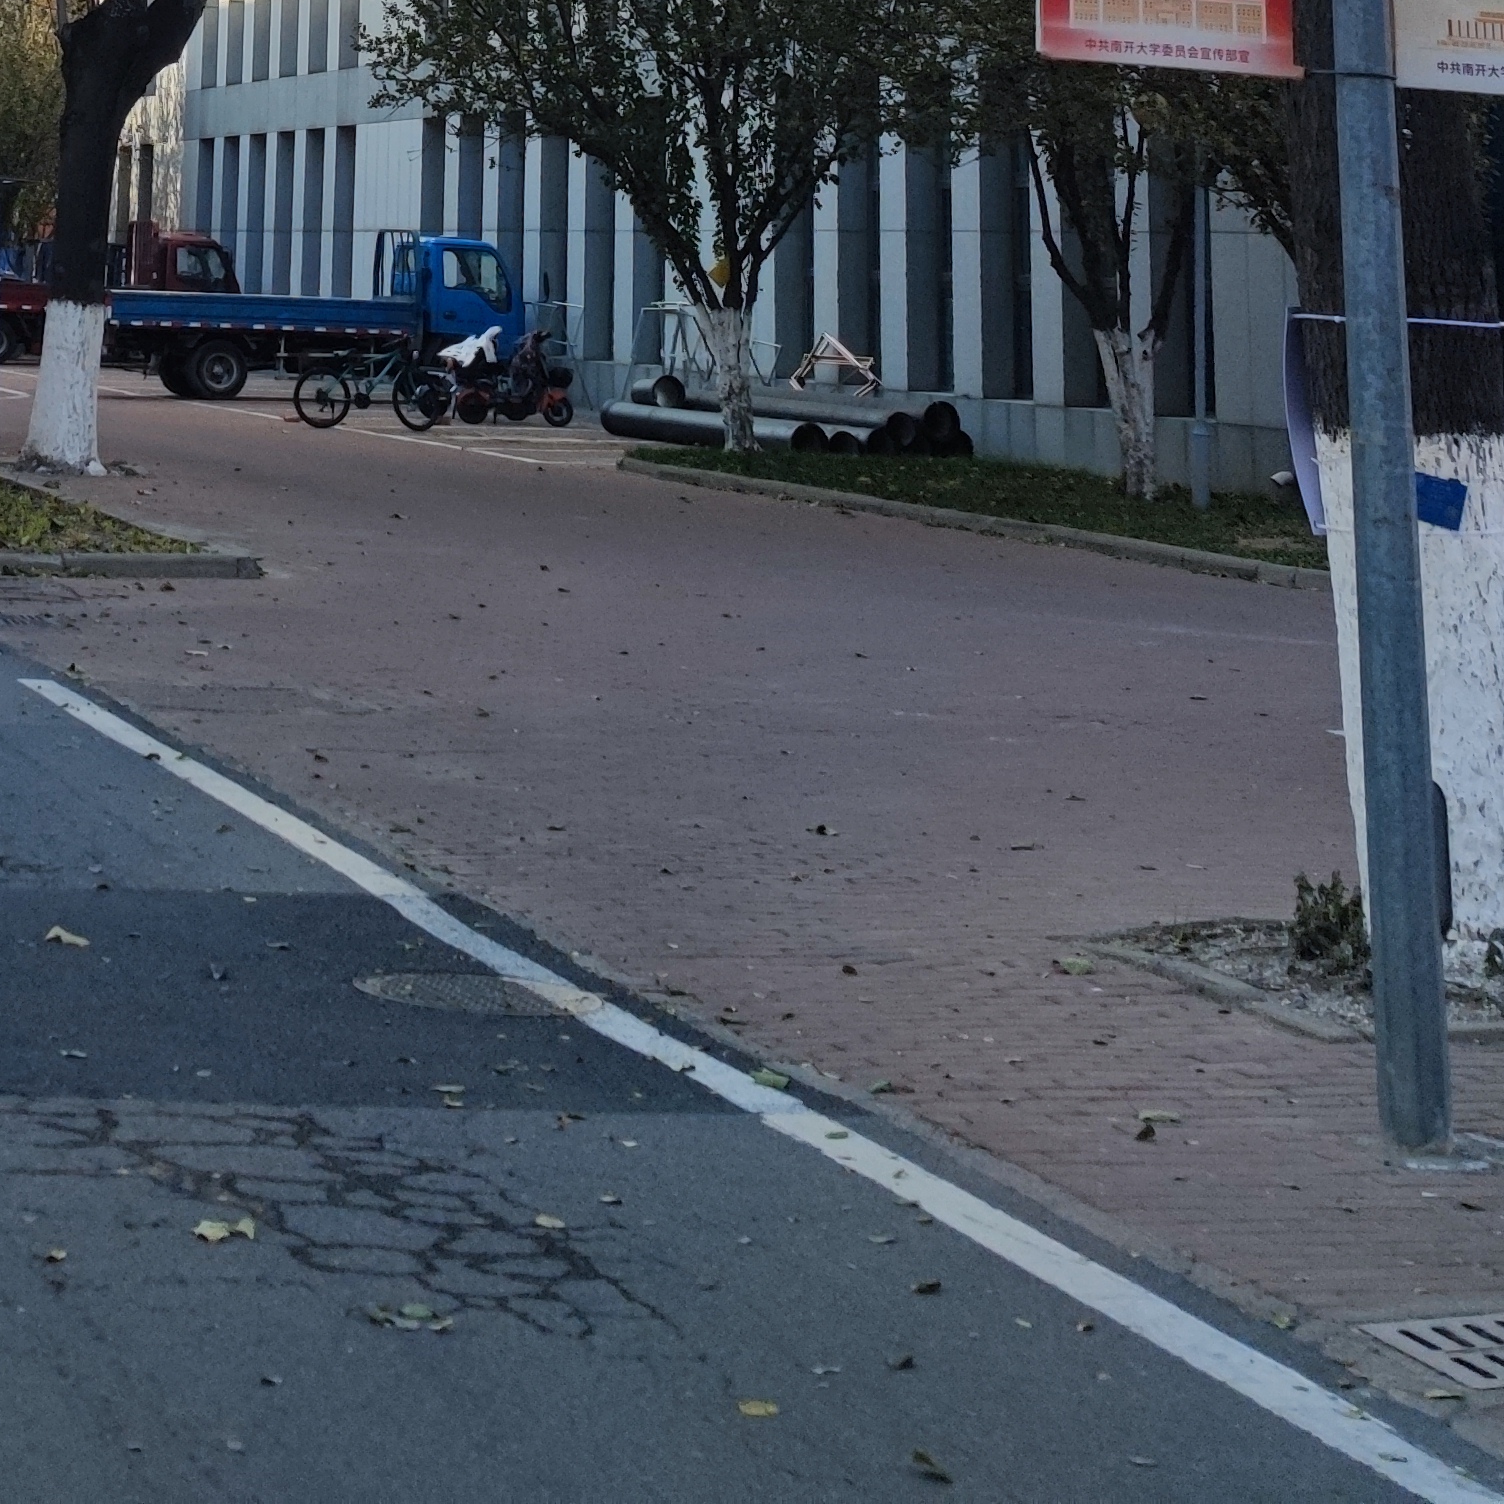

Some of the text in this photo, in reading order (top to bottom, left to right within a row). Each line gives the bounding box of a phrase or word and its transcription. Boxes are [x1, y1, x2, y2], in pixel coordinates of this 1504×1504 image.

[1085, 38, 1250, 64] 中共南开大学委员会宣传部宣
